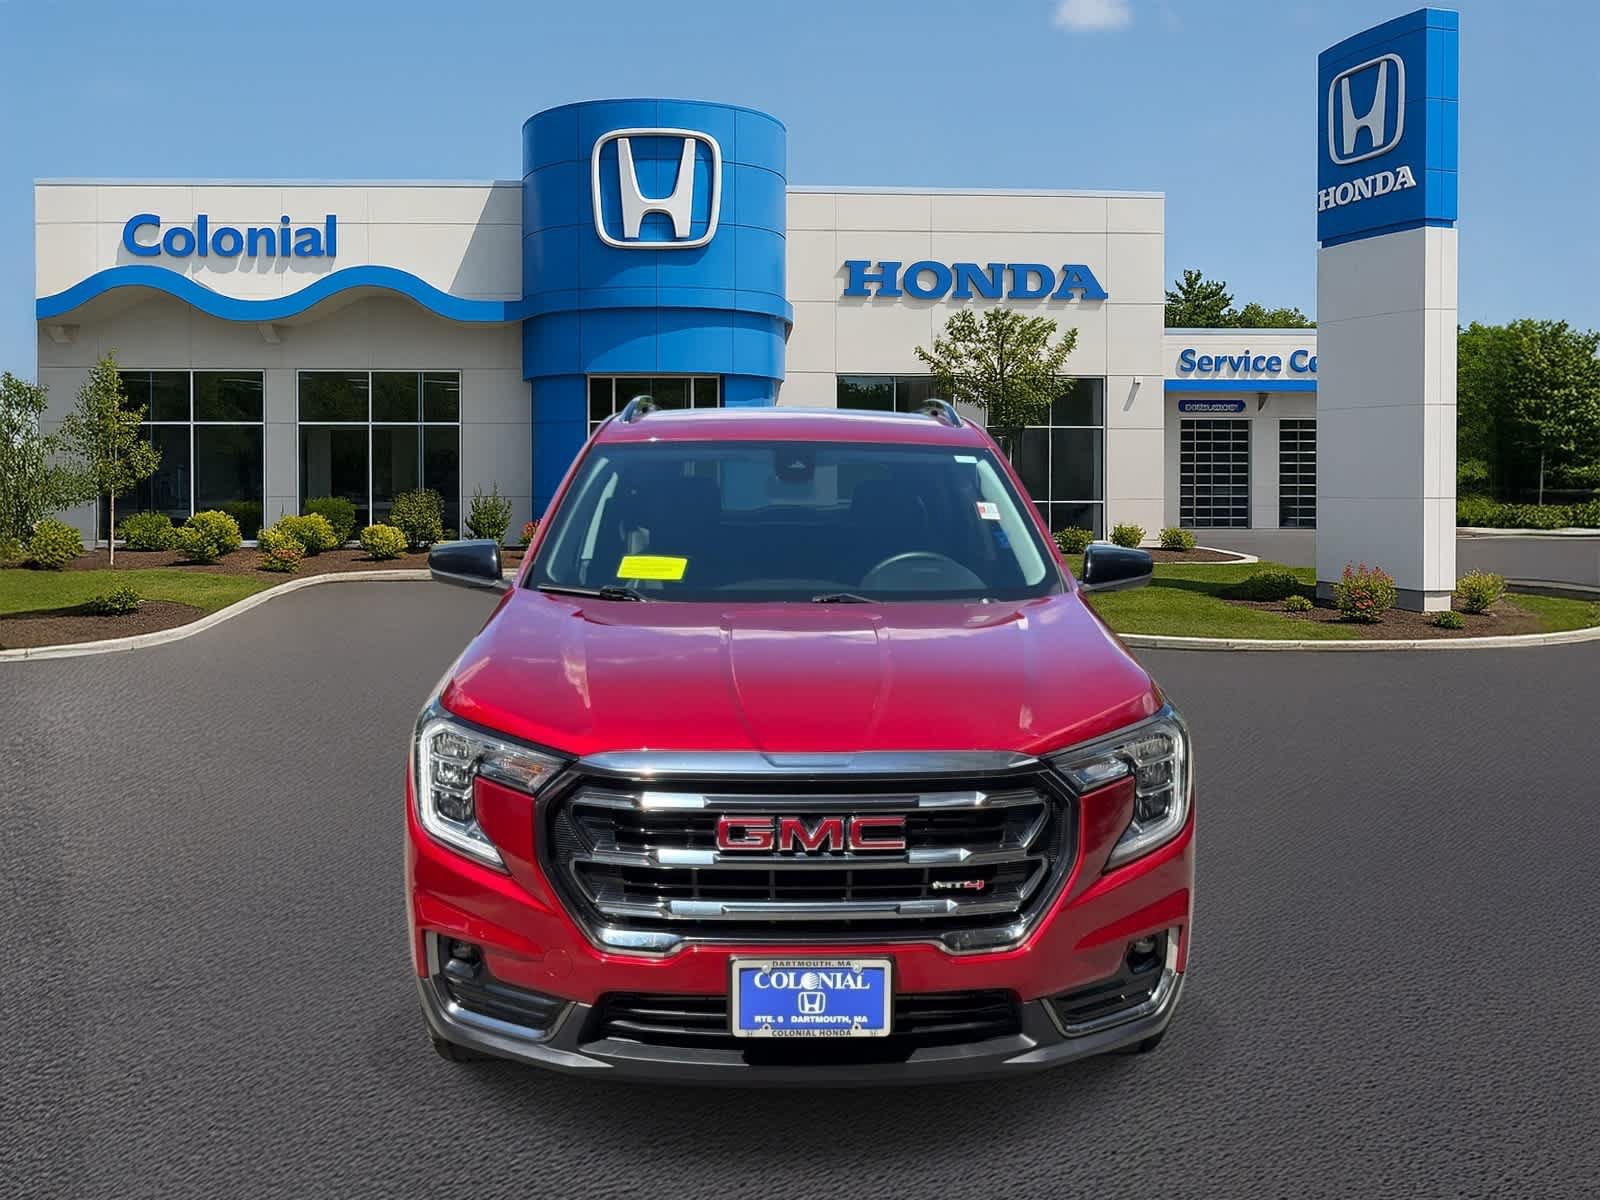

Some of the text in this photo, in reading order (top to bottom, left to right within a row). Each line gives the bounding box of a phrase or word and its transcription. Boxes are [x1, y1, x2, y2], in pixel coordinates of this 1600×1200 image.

[1318, 165, 1417, 212] HONDA
[122, 213, 337, 258] Colonial
[843, 260, 1109, 300] HONDA
[1180, 348, 1282, 373] Service
[716, 815, 906, 851] GMC
[754, 971, 871, 990] COLONIAL
[771, 1029, 852, 1038] COLONIAL HONDA
[854, 1015, 868, 1024] MA
